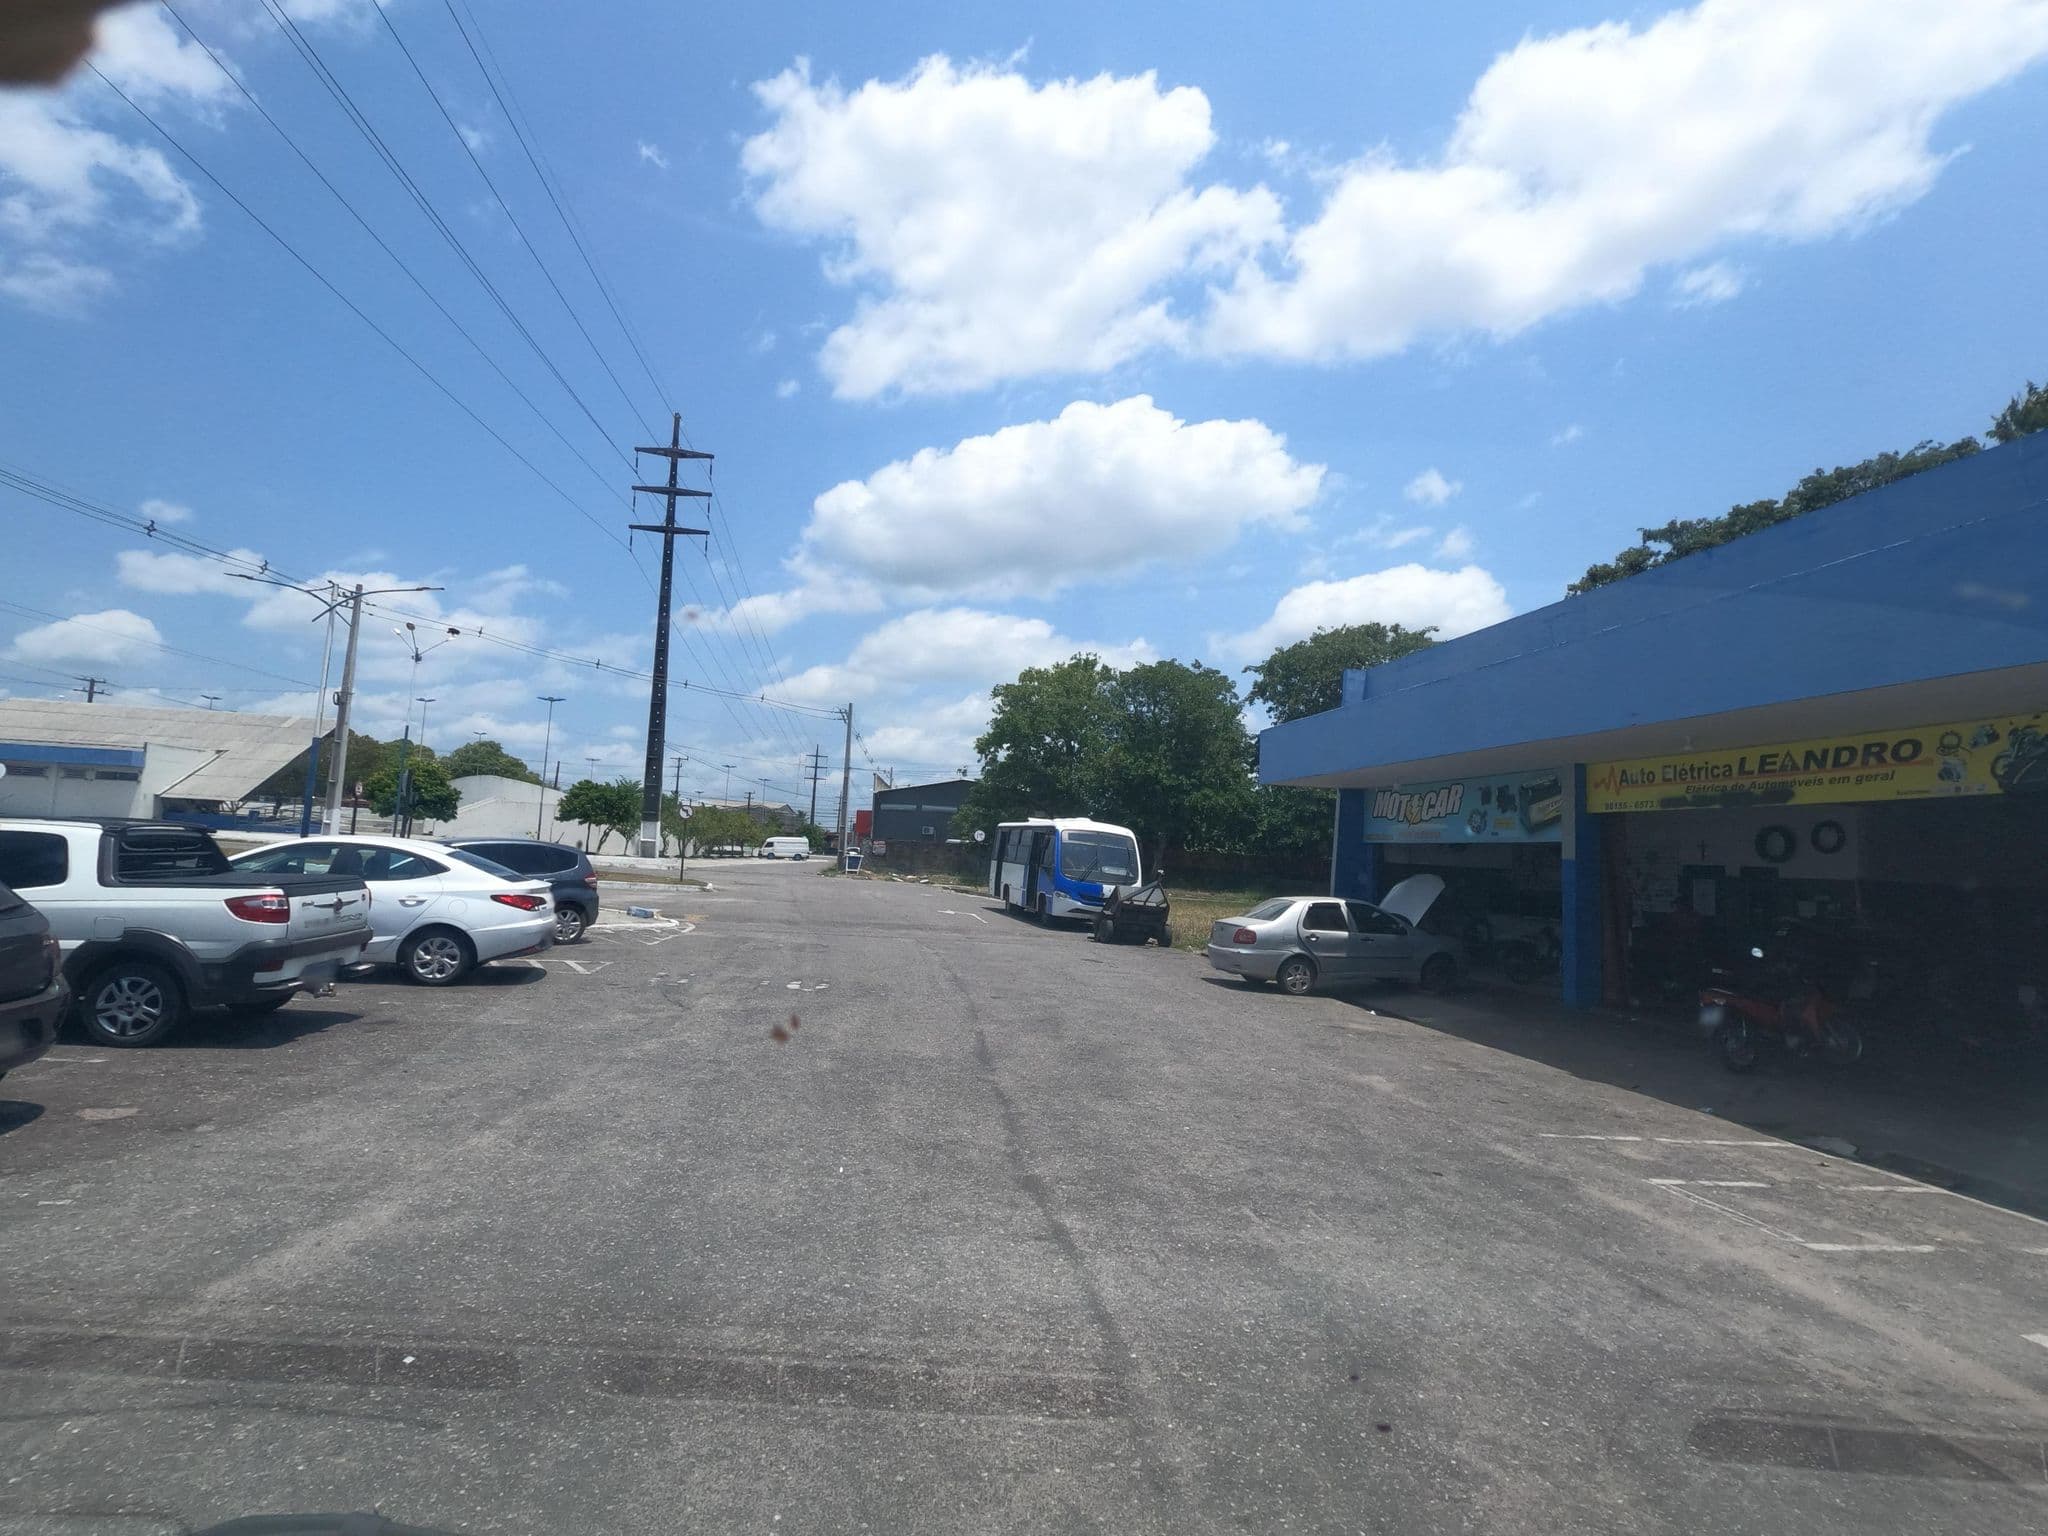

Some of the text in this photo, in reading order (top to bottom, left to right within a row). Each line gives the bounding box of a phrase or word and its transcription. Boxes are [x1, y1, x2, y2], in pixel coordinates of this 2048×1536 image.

[1619, 738, 1923, 786] Auto Elétrica LEANDRO
[1685, 782, 1728, 794] Elétrica
[1828, 774, 1851, 785] em
[1855, 769, 1896, 785] geral
